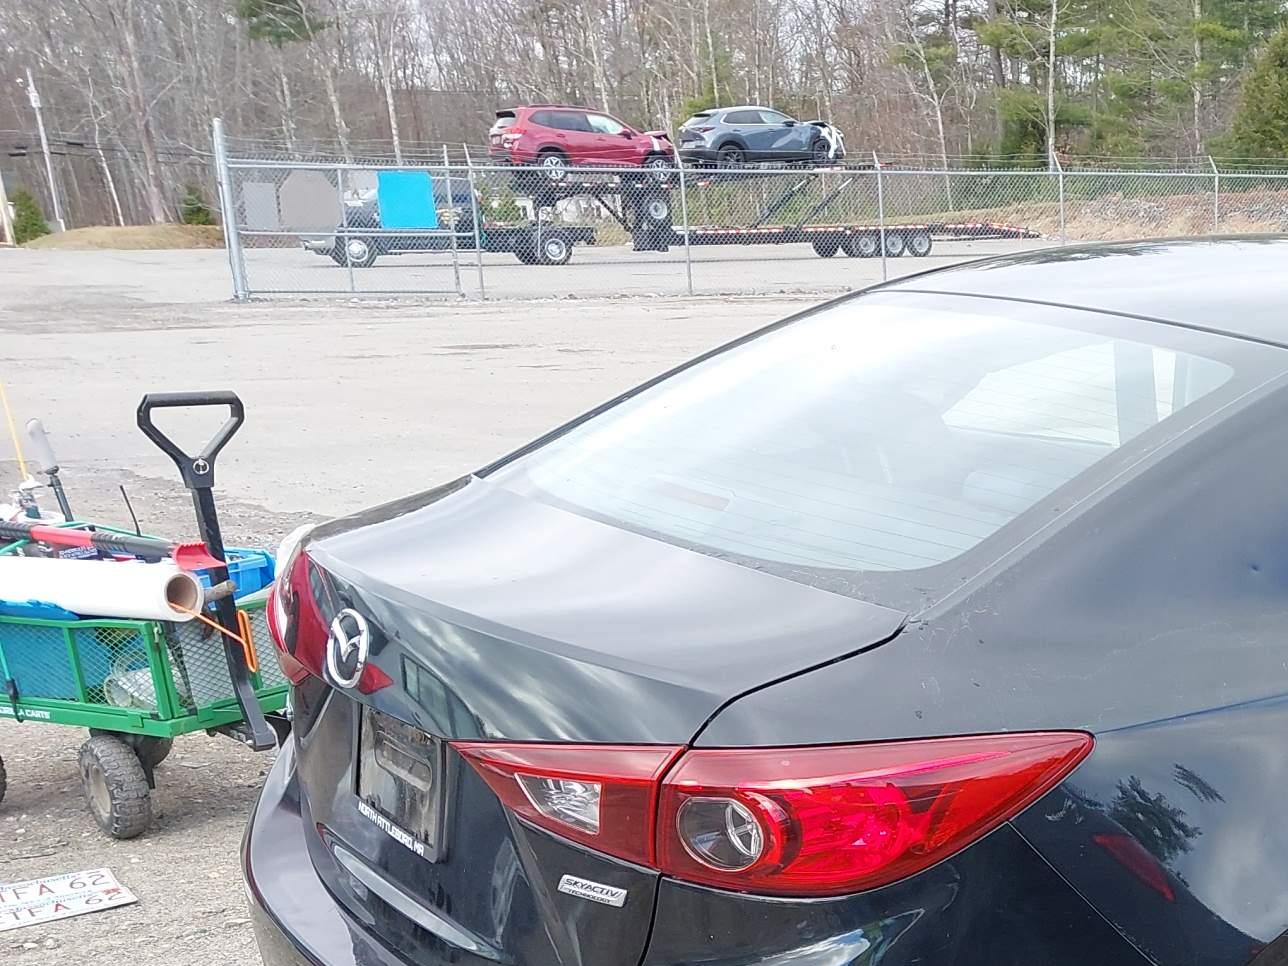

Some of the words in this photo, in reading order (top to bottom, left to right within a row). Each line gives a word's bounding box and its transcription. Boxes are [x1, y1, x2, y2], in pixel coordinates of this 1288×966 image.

[358, 800, 378, 824] NORTH
[413, 840, 425, 857] MA
[69, 874, 111, 890] 62
[564, 878, 619, 897] SKYACTIV
[85, 891, 127, 905] 62
[568, 889, 611, 904] TECHNOLOGY
